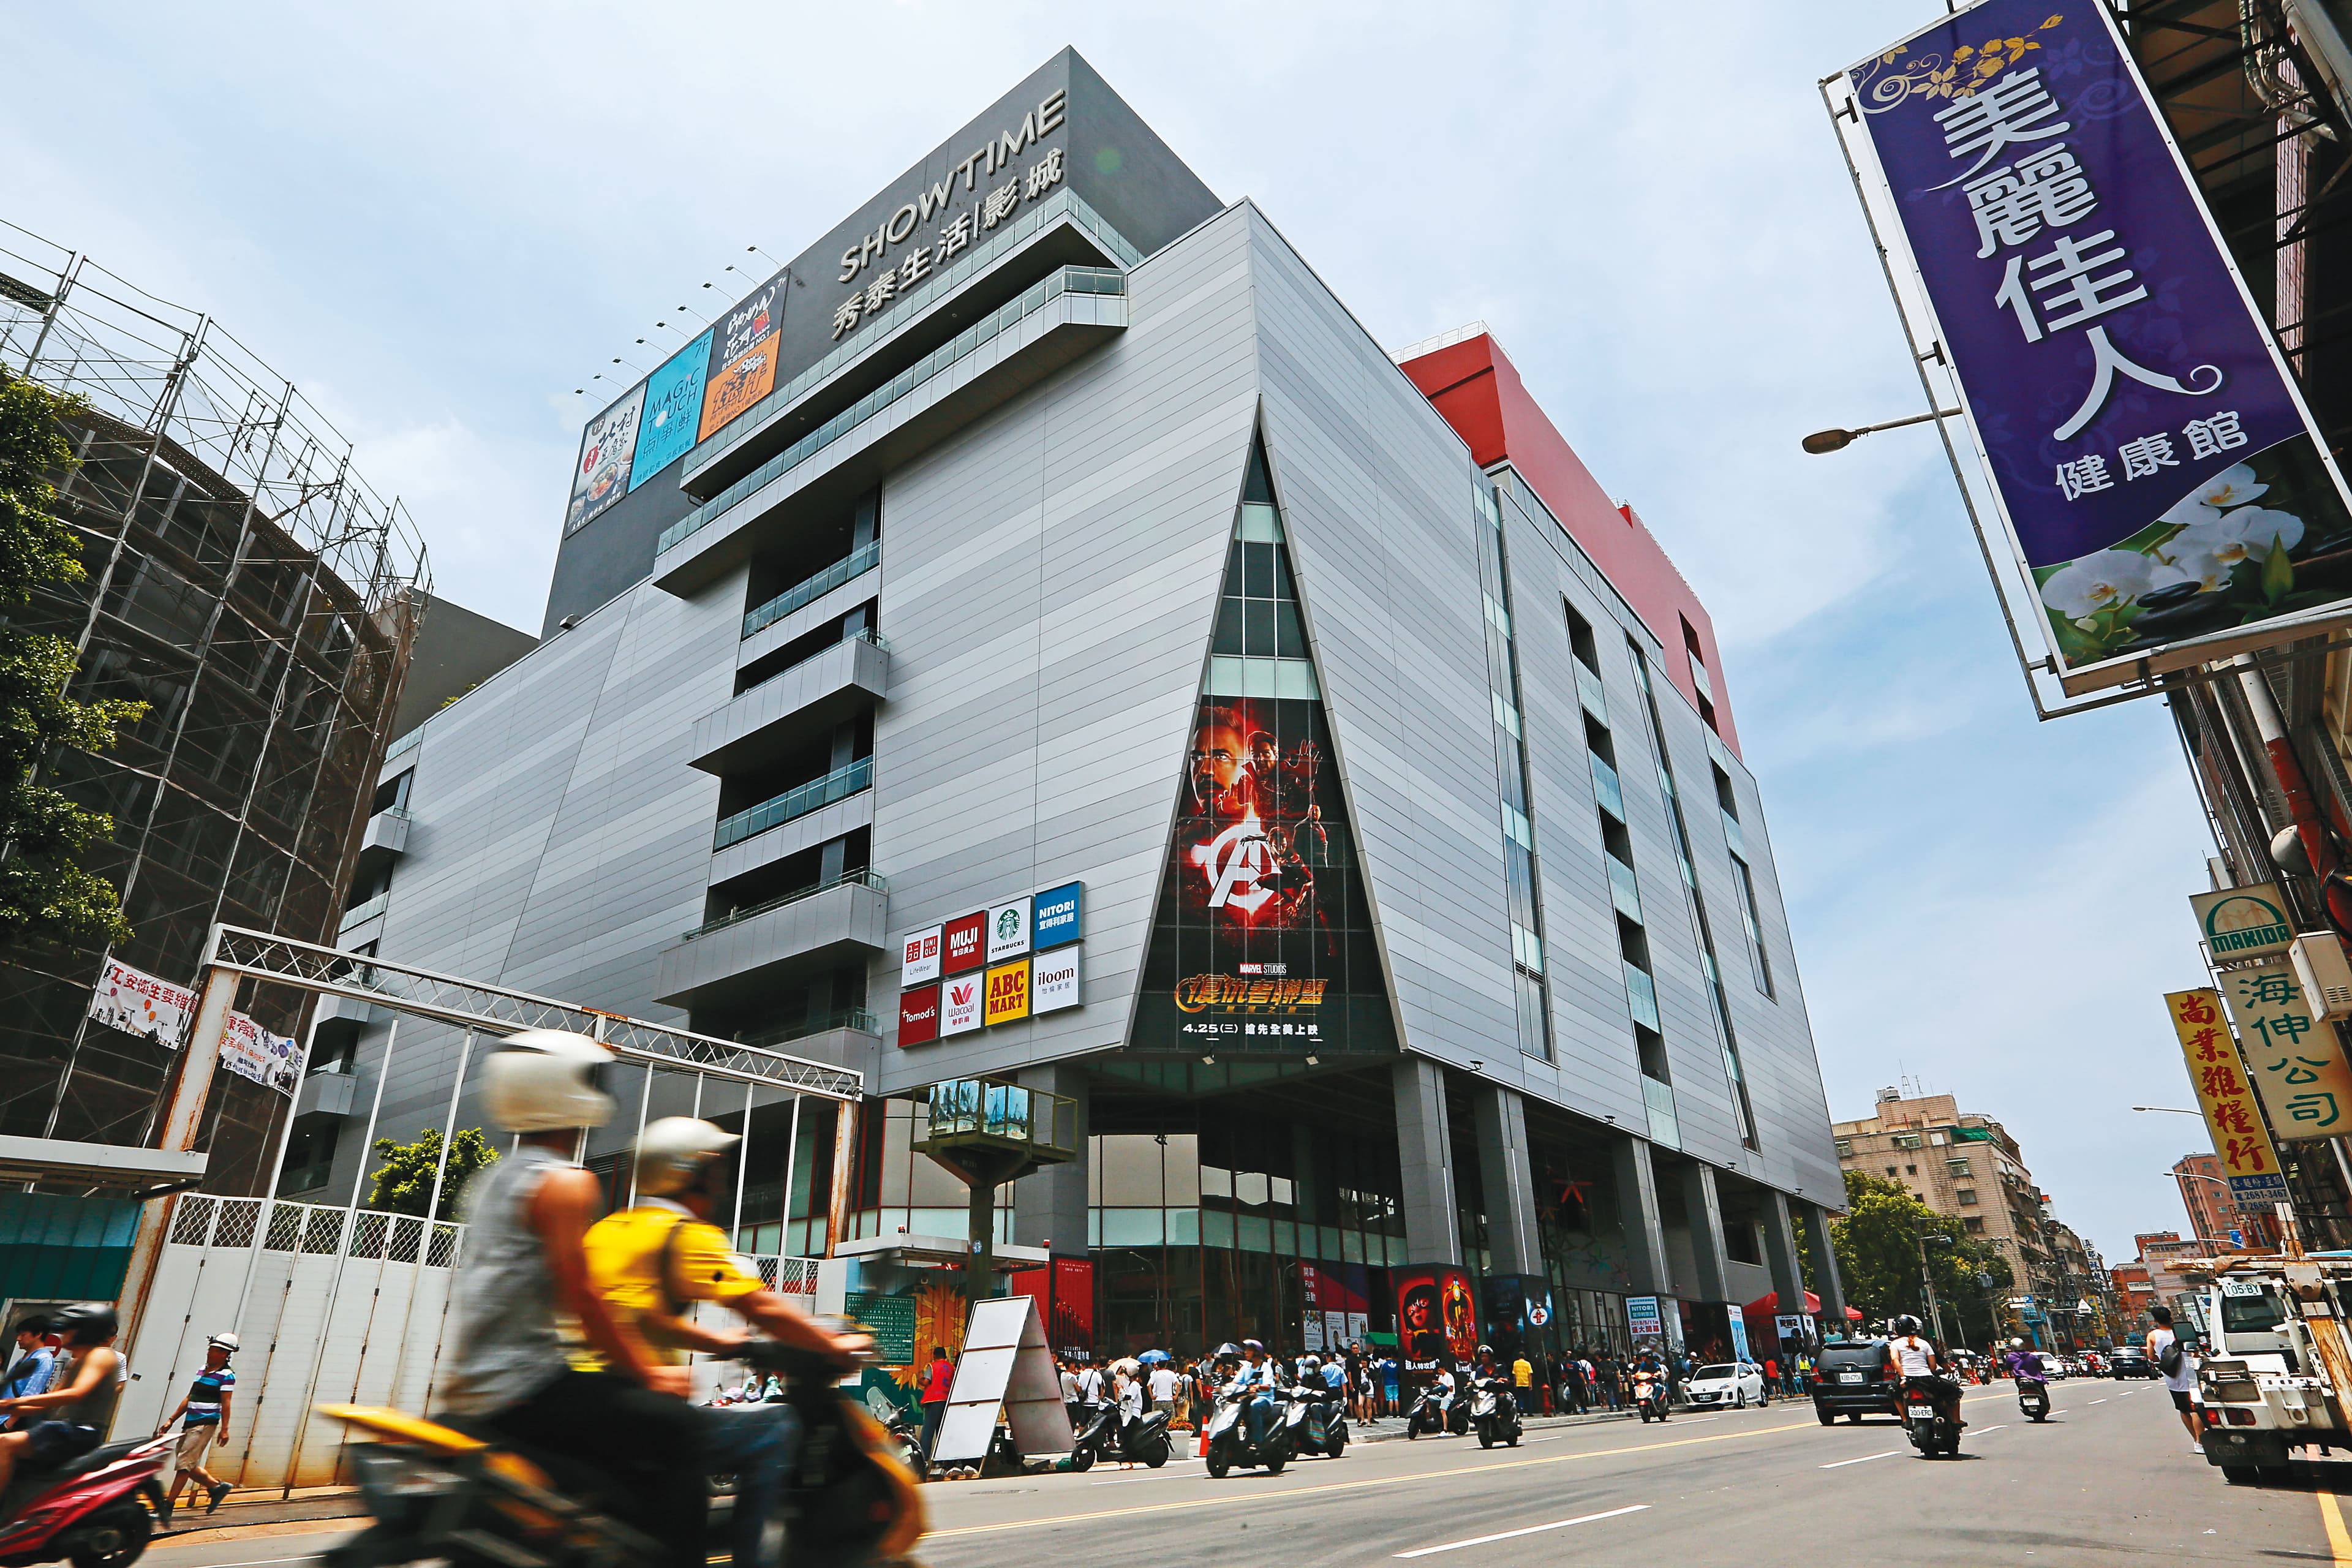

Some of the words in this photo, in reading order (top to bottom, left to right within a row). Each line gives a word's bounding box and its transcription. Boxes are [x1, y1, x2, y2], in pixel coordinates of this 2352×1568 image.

[839, 88, 1065, 282] SHOWTIME
[1924, 67, 2223, 442] 美麗佳人
[695, 336, 709, 358] 7F
[755, 331, 770, 345] NO.1
[594, 418, 605, 434] 7F
[598, 405, 636, 451] 北村
[2054, 410, 2248, 502] 健康館
[1039, 900, 1074, 919] NITORI
[1039, 913, 1074, 930] 宜得利家居
[925, 938, 936, 948] UNI
[950, 927, 978, 949] MUJI
[991, 940, 1025, 953] STARBUCKS
[2209, 924, 2293, 953] MAKIDA
[924, 946, 937, 956] QLO
[952, 945, 975, 957] 無印良品
[910, 964, 931, 975] LifeWear
[1038, 967, 1074, 986] iloom
[1240, 964, 1262, 973] MARVEL
[1264, 965, 1286, 973] STUDIOS
[990, 970, 1024, 998] ABC
[1187, 973, 1328, 1005] 復仇者聯盟
[948, 1003, 974, 1017] Wacoal
[989, 993, 1023, 1014] MART
[1245, 1023, 1318, 1035] 搶先全美上映
[2239, 973, 2339, 1126] 海伸公司
[2244, 1189, 2287, 1200] 2681-3467
